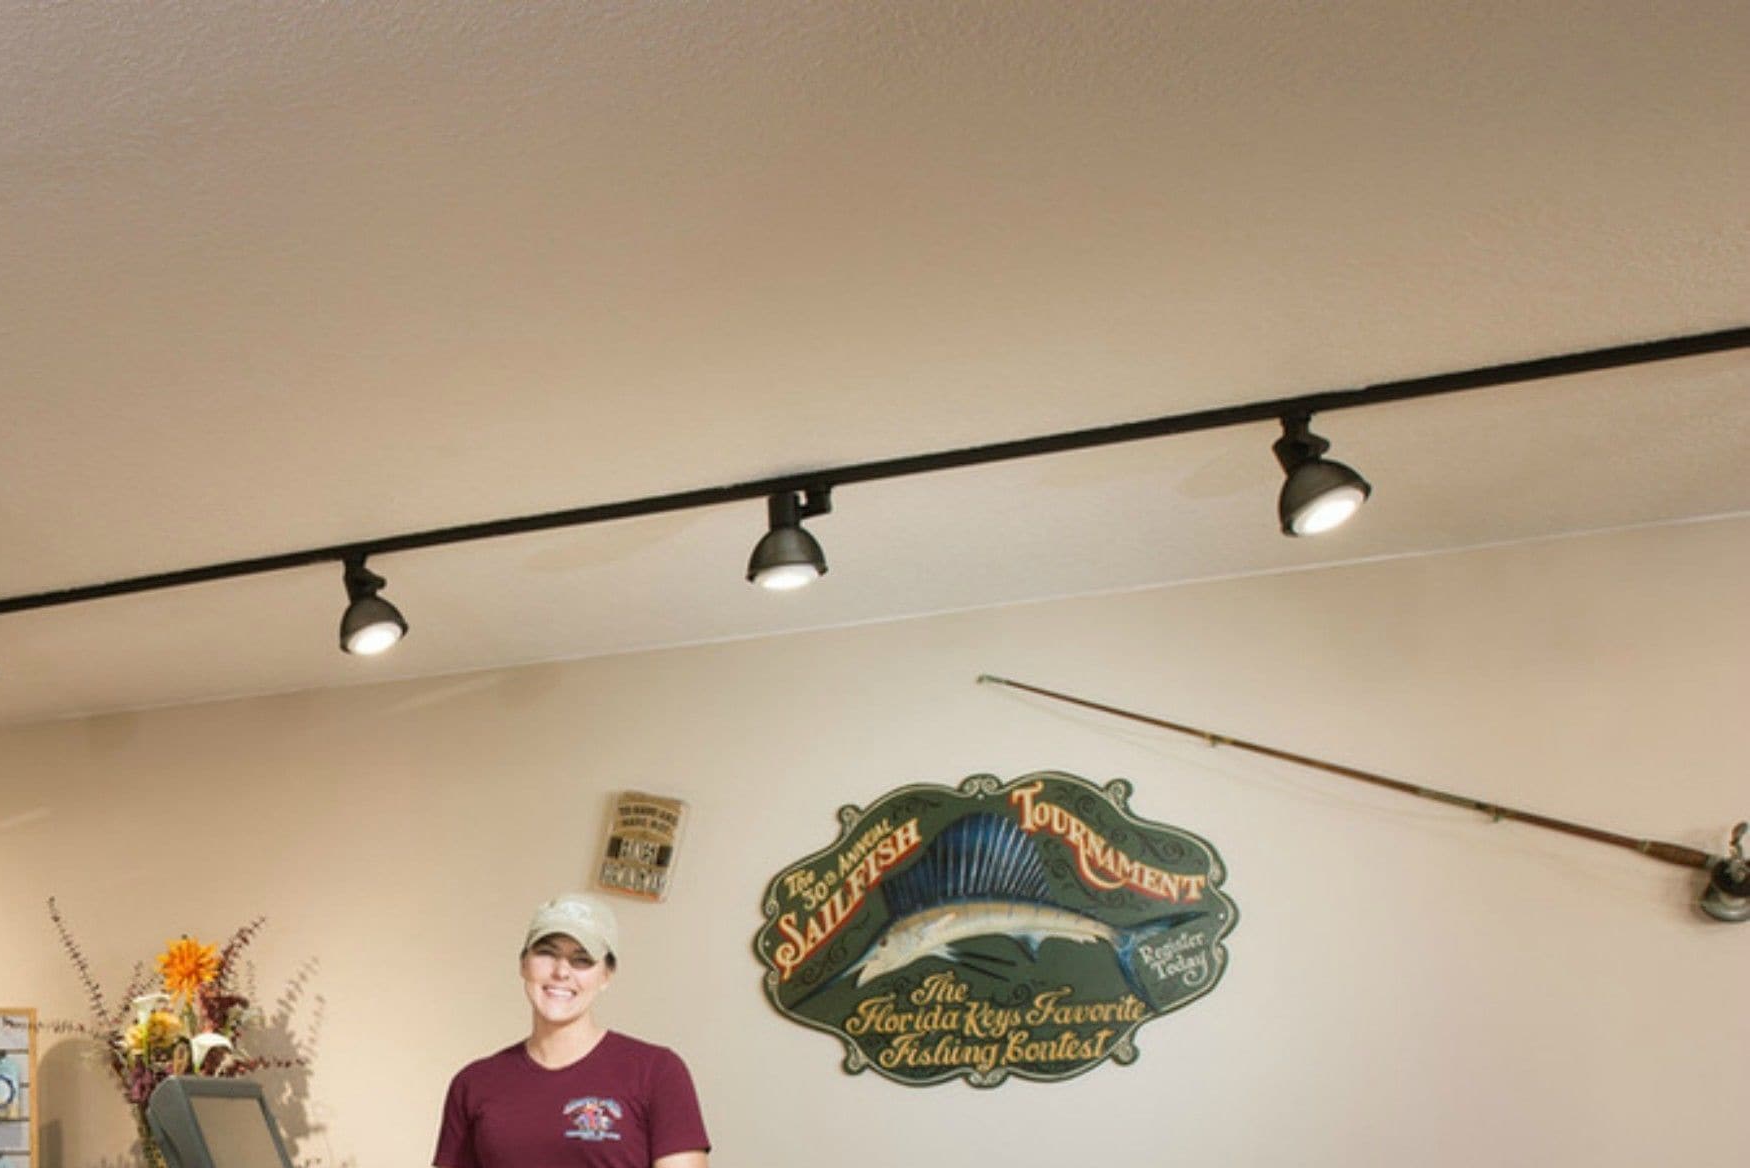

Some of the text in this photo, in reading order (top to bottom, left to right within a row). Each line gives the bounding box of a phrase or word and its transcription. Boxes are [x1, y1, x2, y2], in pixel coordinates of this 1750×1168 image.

[1009, 781, 1206, 904] TOURNAMENT
[774, 817, 923, 981] SAILFISH
[1139, 932, 1206, 965] Register
[1150, 949, 1209, 988] Today
[911, 971, 970, 1004] The
[846, 985, 1148, 1039] Florida Keys Favorite
[879, 1029, 1115, 1073] Fishing Contest
